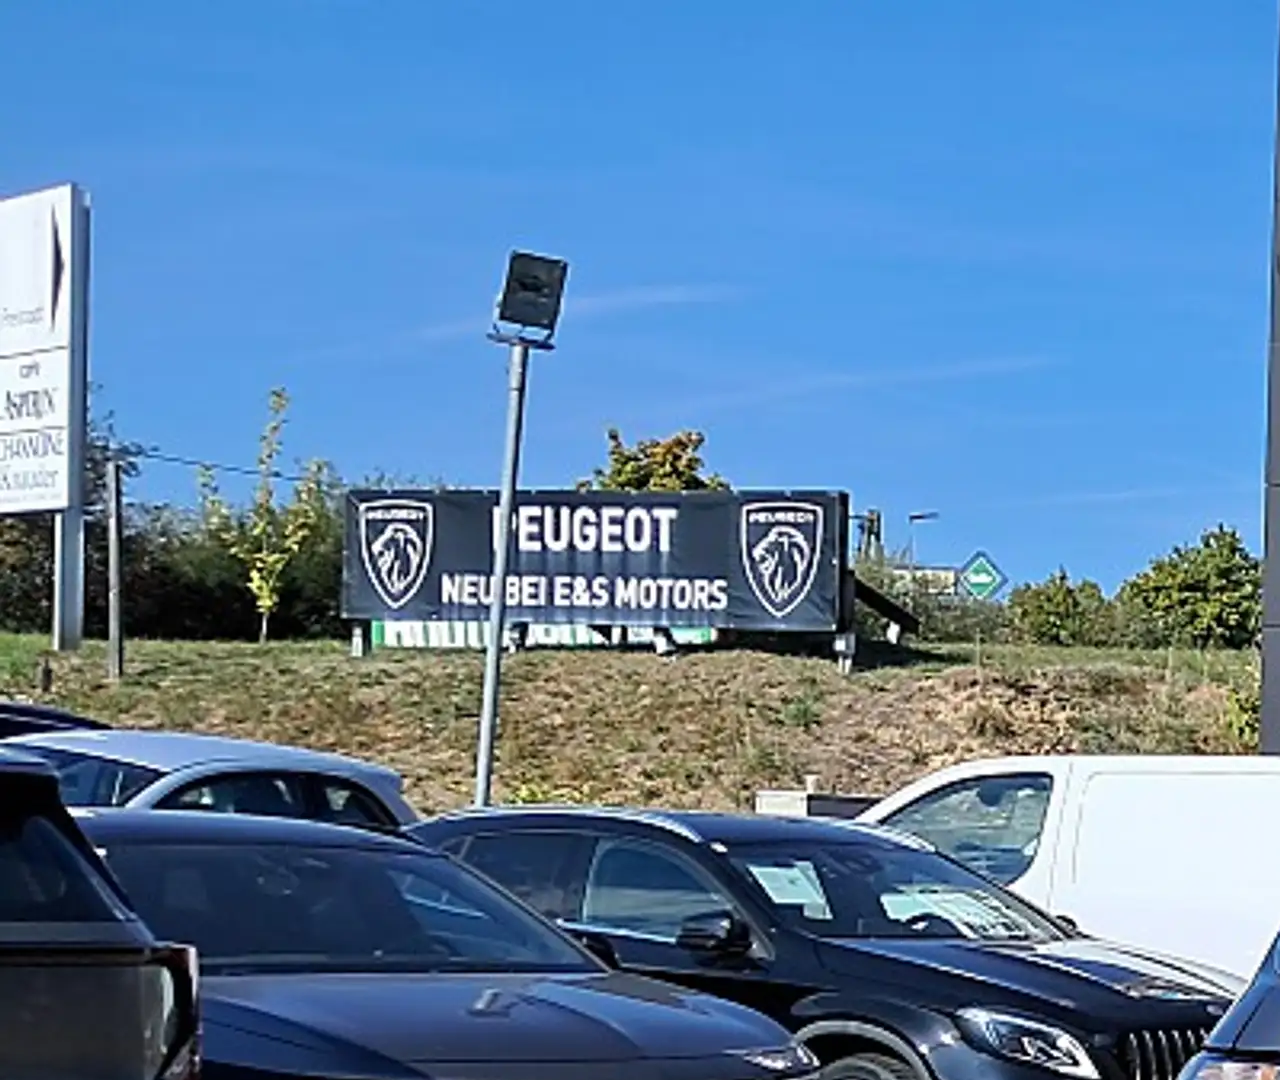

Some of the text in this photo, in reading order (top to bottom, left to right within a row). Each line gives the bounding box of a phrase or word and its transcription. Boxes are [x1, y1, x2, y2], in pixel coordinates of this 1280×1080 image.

[441, 573, 729, 610] NEU BEI E&S MOTORS
